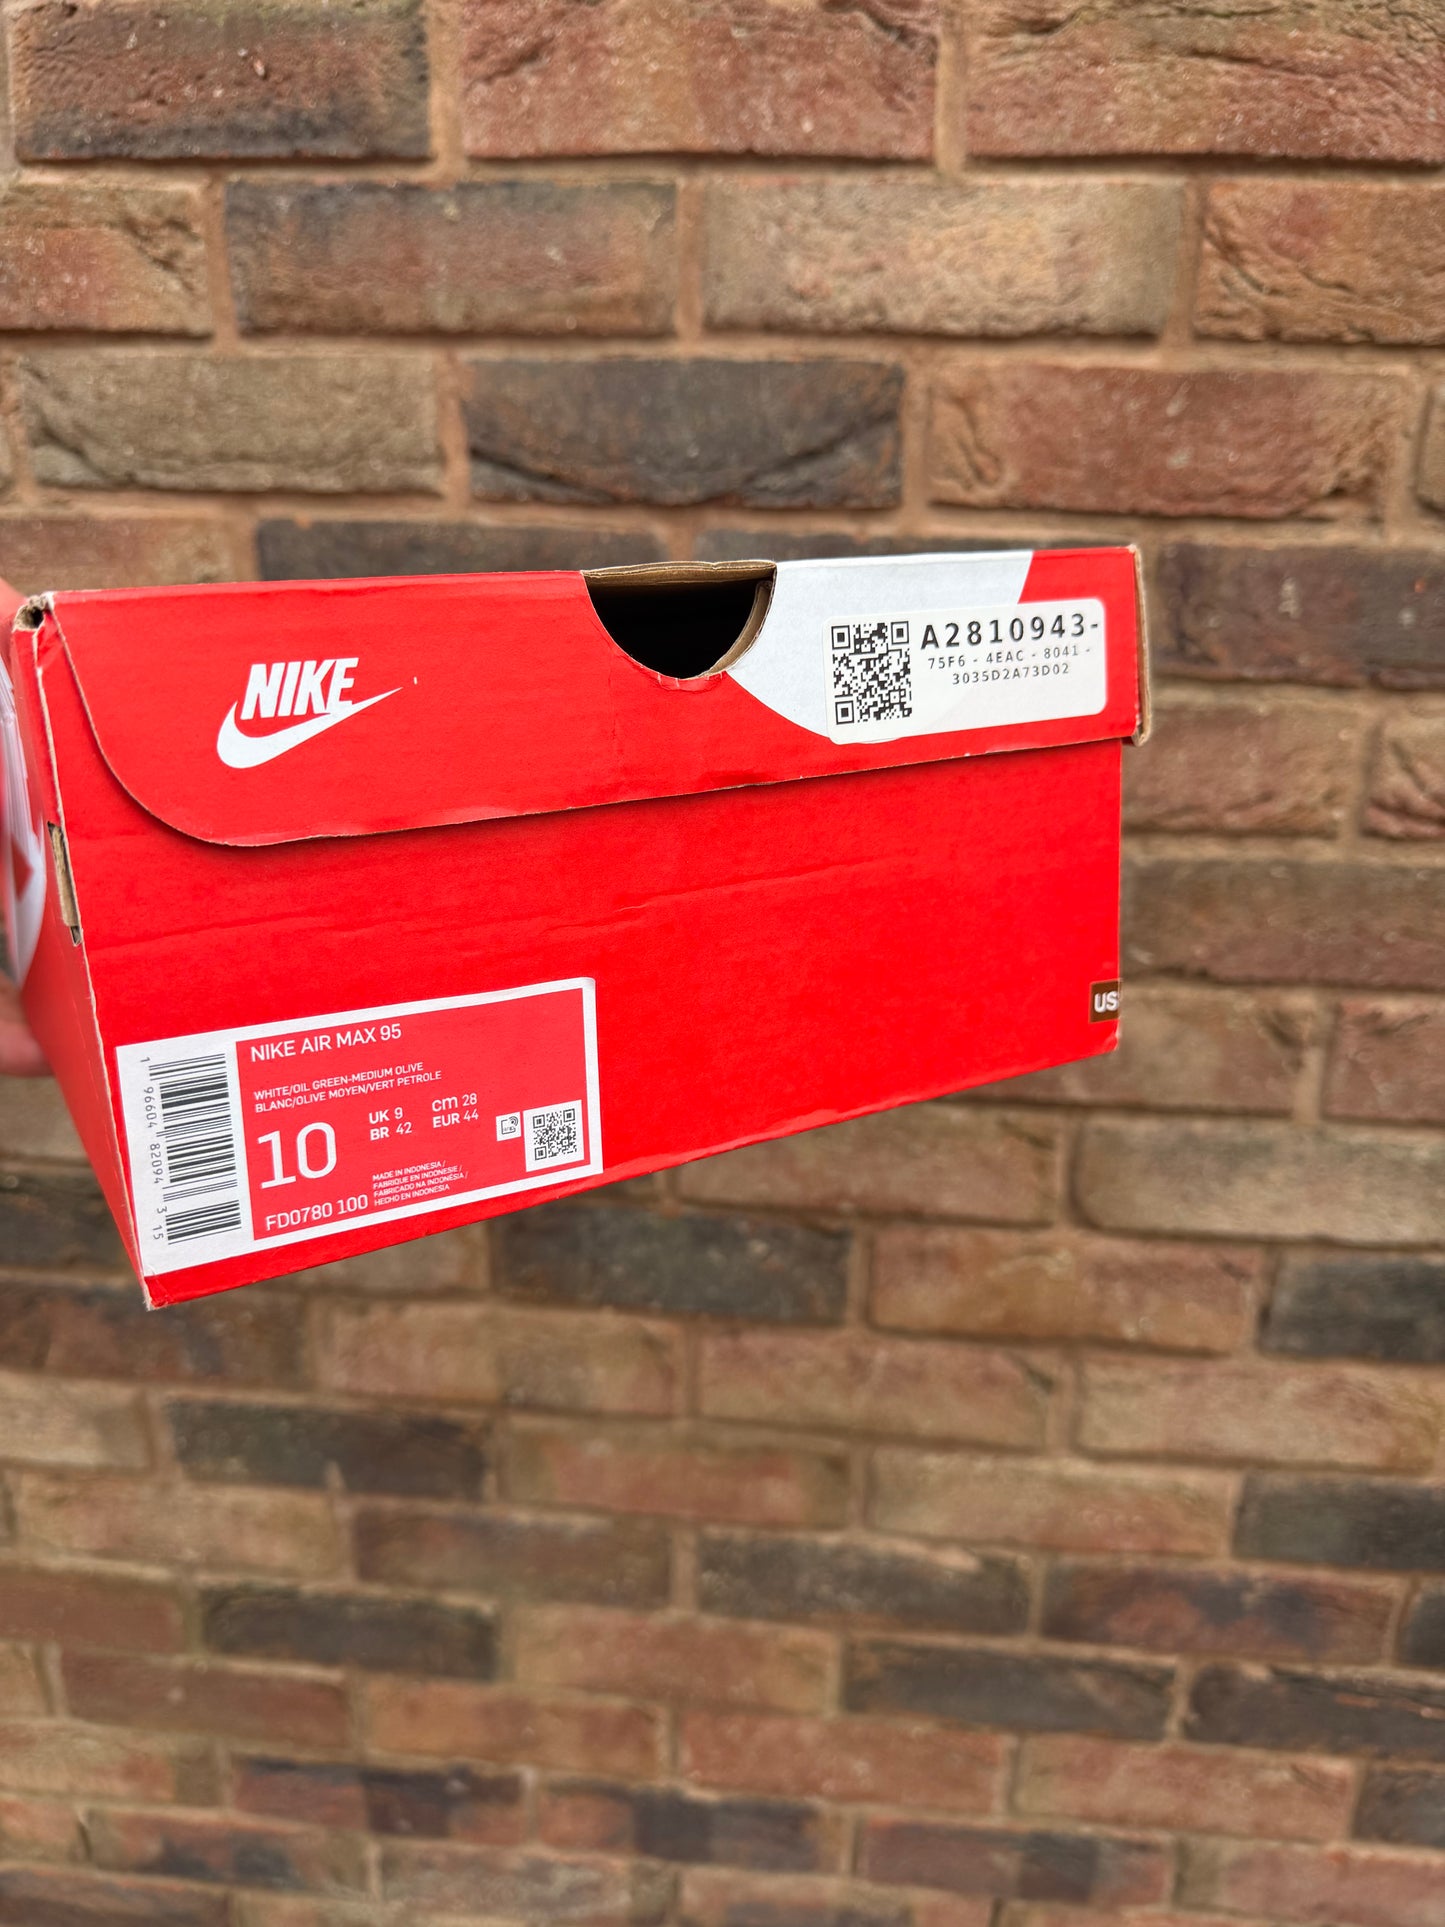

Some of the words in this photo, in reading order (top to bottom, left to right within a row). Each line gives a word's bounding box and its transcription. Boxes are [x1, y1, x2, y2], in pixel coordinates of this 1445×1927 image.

[920, 613, 1099, 650] A2810943-
[928, 655, 966, 669] 75F6
[986, 650, 1024, 664] 4EAC
[1044, 645, 1079, 659] 8041
[952, 662, 1069, 685] 3035D2A73D02
[240, 657, 359, 721] NIKE
[250, 1040, 296, 1062] NIKE
[300, 1035, 332, 1055] AIR
[336, 1027, 376, 1048] MAX
[380, 1023, 402, 1041] 95
[254, 1084, 310, 1101] WHITE/OIL
[312, 1068, 394, 1090] GREEN-MEDIUM
[395, 1062, 424, 1076] OLIVE
[255, 1093, 327, 1113] BLANC/OLIVE
[328, 1079, 395, 1099] MOYEN/VERT
[397, 1071, 442, 1087] PETROLE
[144, 1086, 158, 1129] 96604
[431, 1096, 459, 1112] cm
[462, 1093, 478, 1107] 28
[368, 1109, 390, 1125] UK
[394, 1106, 404, 1120] 9
[432, 1112, 461, 1129] EUR
[463, 1108, 479, 1122] 44
[369, 1126, 390, 1141] BR
[395, 1121, 413, 1135] 42
[150, 1143, 164, 1184] 82094
[257, 1122, 337, 1189] 10
[372, 1172, 394, 1182] MADE
[395, 1168, 403, 1177] IN
[404, 1161, 442, 1175] INDONESIA
[409, 1174, 421, 1182] EN
[374, 1183, 415, 1198] FABRICADO
[415, 1179, 427, 1188] NA
[375, 1195, 400, 1206] HECHO
[401, 1192, 412, 1201] EN
[412, 1184, 451, 1198] INDONESIA
[157, 1206, 168, 1214] 3
[265, 1202, 333, 1231] FD0780
[336, 1194, 369, 1215] 100
